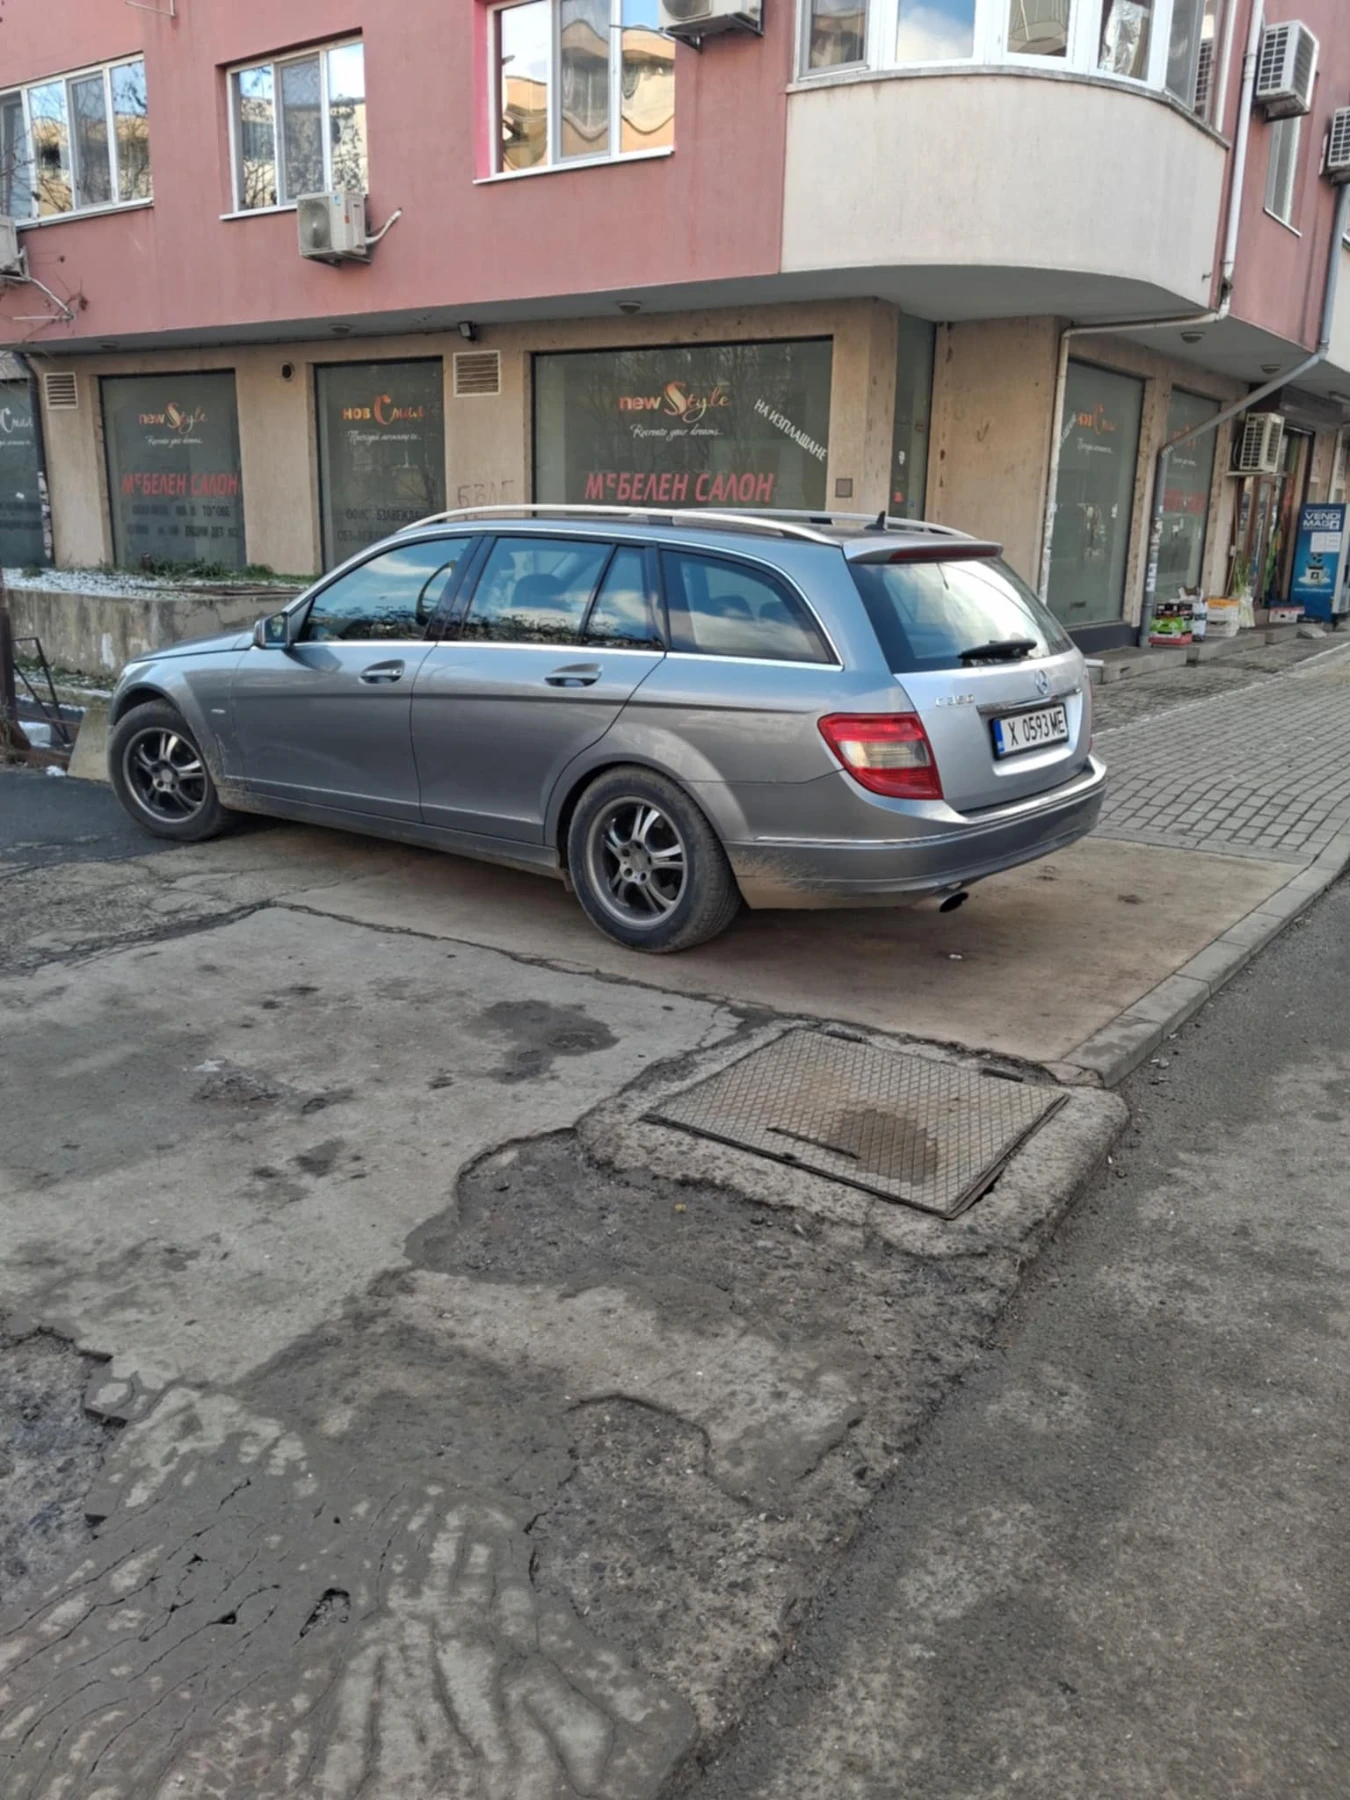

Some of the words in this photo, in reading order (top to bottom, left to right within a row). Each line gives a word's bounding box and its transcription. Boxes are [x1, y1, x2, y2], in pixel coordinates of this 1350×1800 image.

[618, 395, 662, 411] new
[663, 381, 731, 424] Style
[754, 398, 770, 418] НА
[138, 413, 165, 425] new
[190, 472, 240, 497] САЛОН
[695, 472, 775, 503] САЛОН
